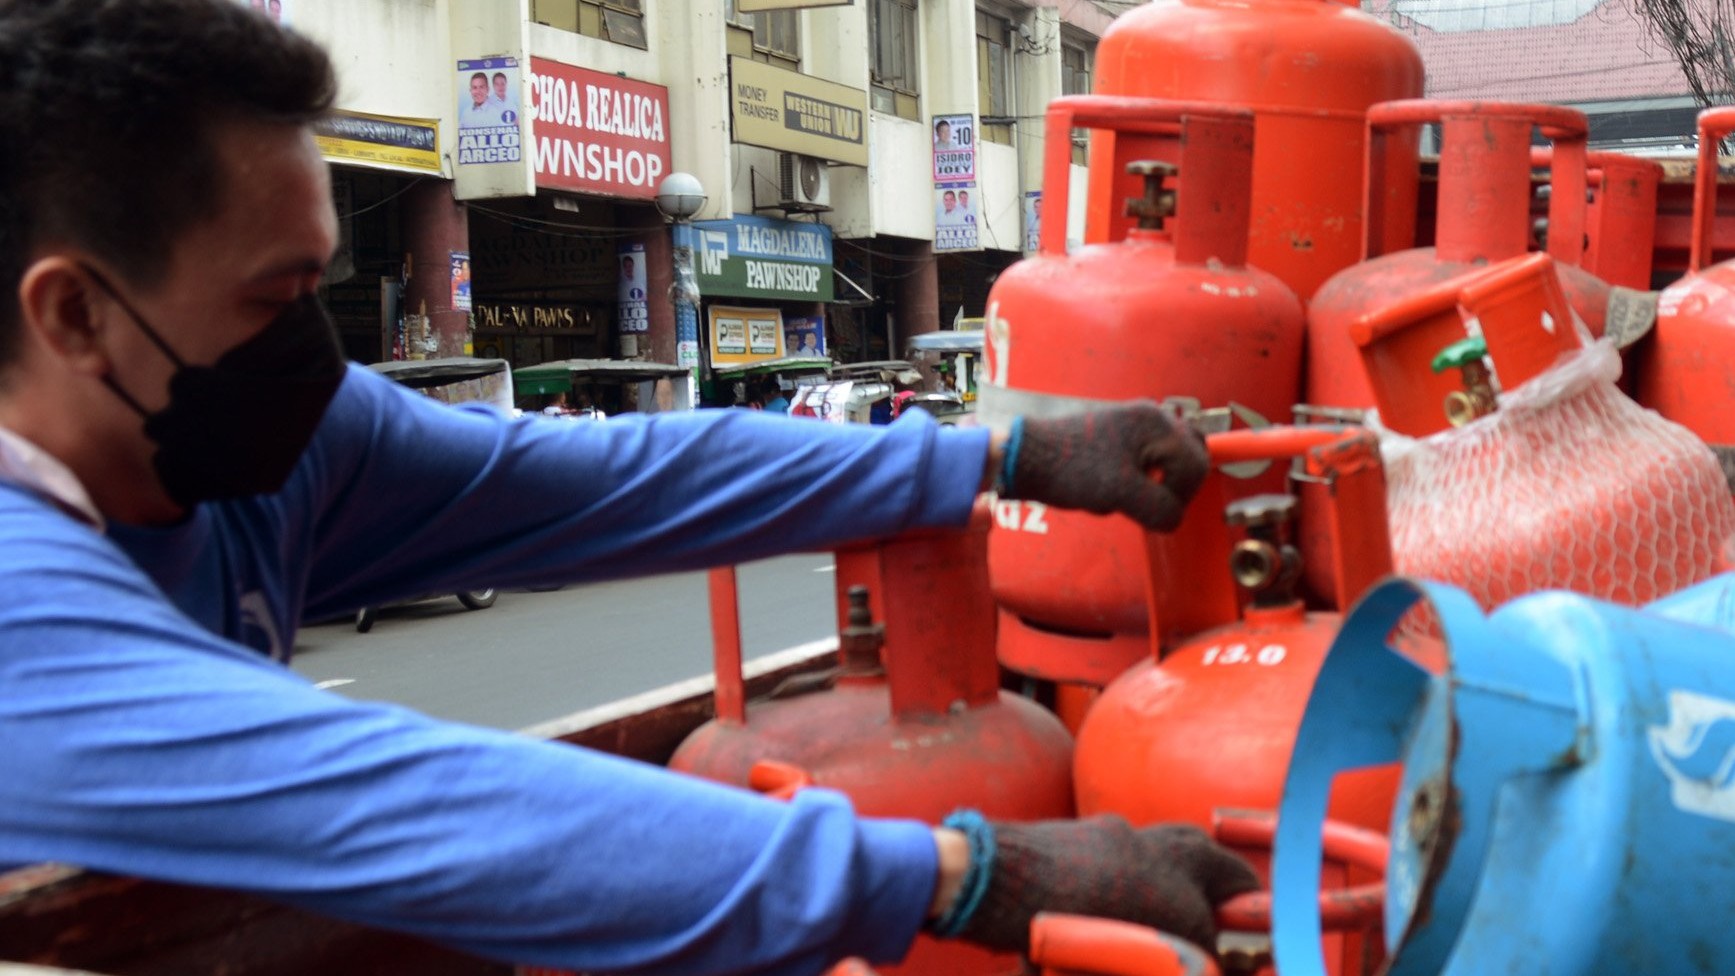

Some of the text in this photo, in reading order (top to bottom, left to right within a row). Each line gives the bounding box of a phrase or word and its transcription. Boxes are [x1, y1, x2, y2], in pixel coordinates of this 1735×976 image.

[738, 84, 767, 102] MONEY
[505, 111, 511, 123] 1
[586, 84, 664, 142] REALICA
[739, 101, 779, 122] TRANSFER
[786, 95, 831, 120] WESTERN
[800, 114, 831, 134] UNION
[834, 107, 860, 140] WU
[459, 134, 519, 149] ALLO
[460, 148, 520, 163] ARCEO
[937, 153, 971, 163] ISIDRO
[939, 166, 970, 174] JOEY
[737, 224, 826, 260] MAGDALENA
[745, 260, 820, 292] PAWNSHOP
